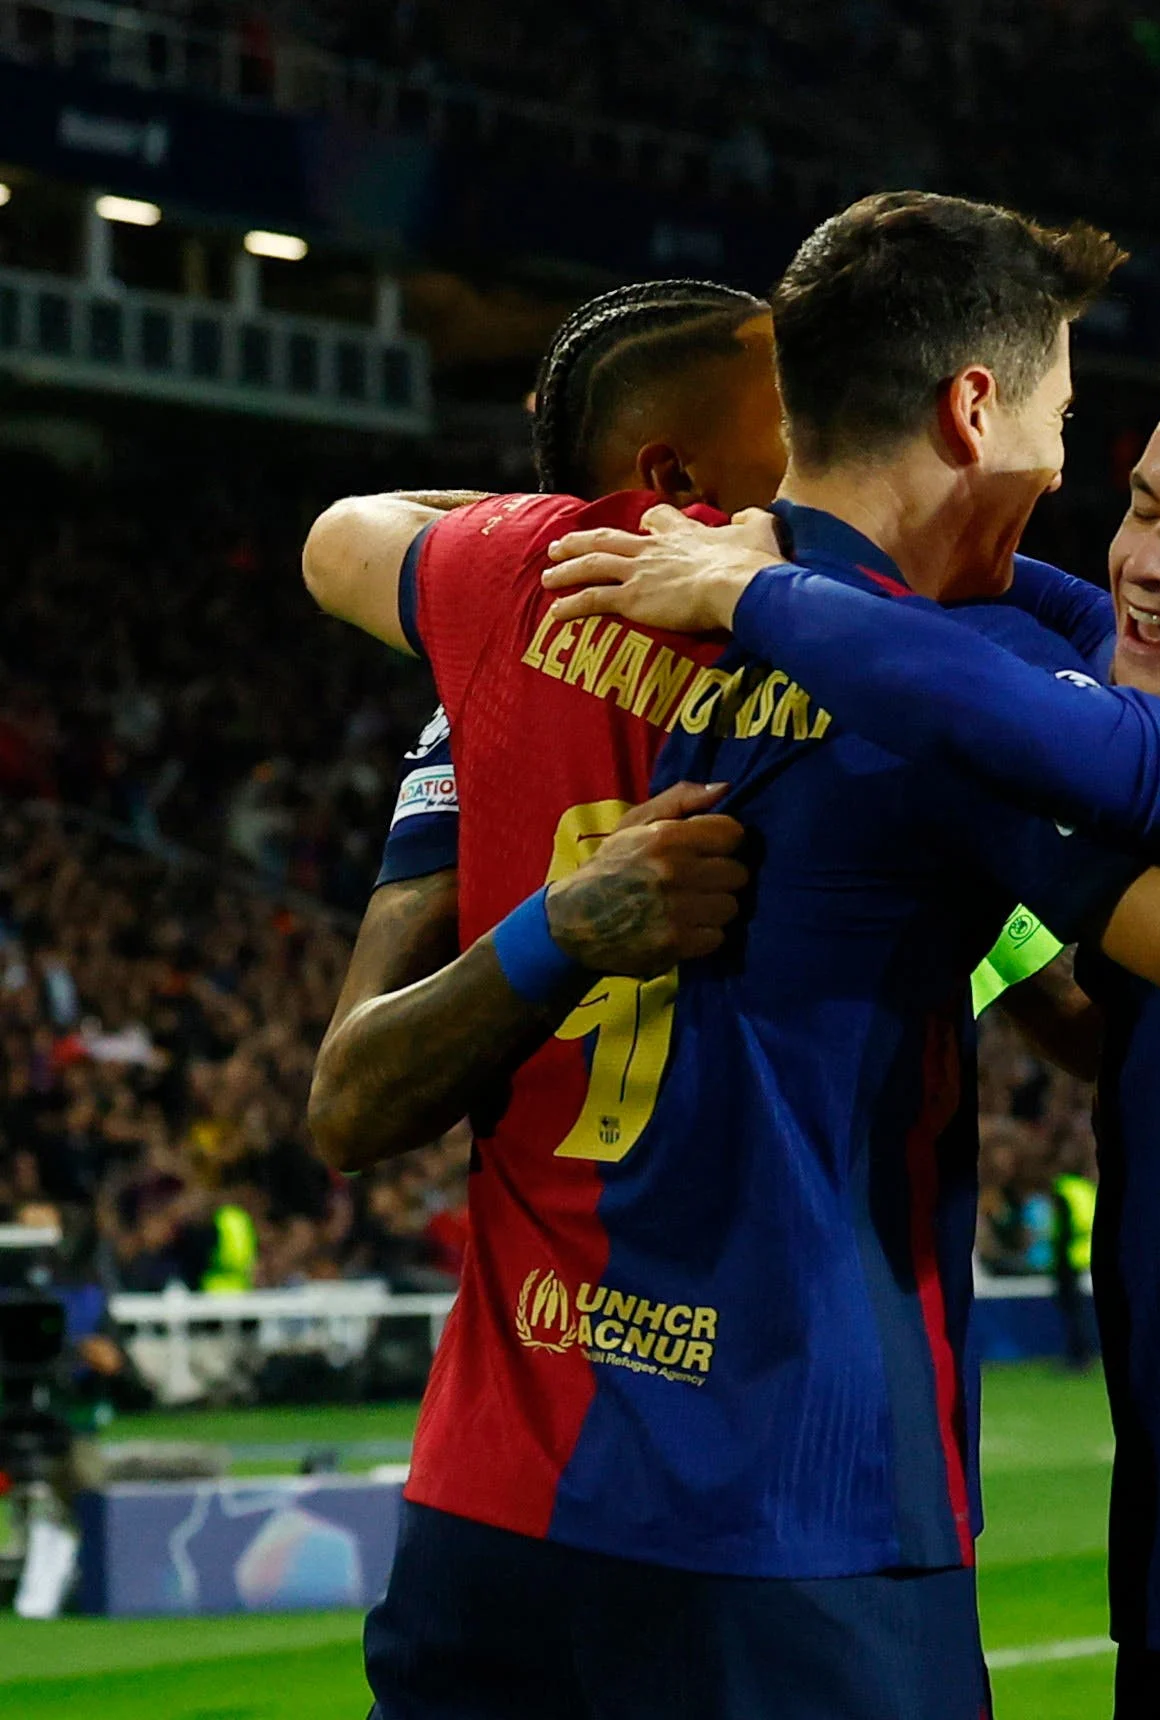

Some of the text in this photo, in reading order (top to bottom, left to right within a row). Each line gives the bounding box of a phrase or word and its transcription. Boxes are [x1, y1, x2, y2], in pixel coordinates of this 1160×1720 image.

[575, 1282, 718, 1340] UNHCR
[577, 1315, 713, 1373] ACNUR
[605, 1352, 657, 1375] Refugee
[658, 1366, 706, 1387] Agency
